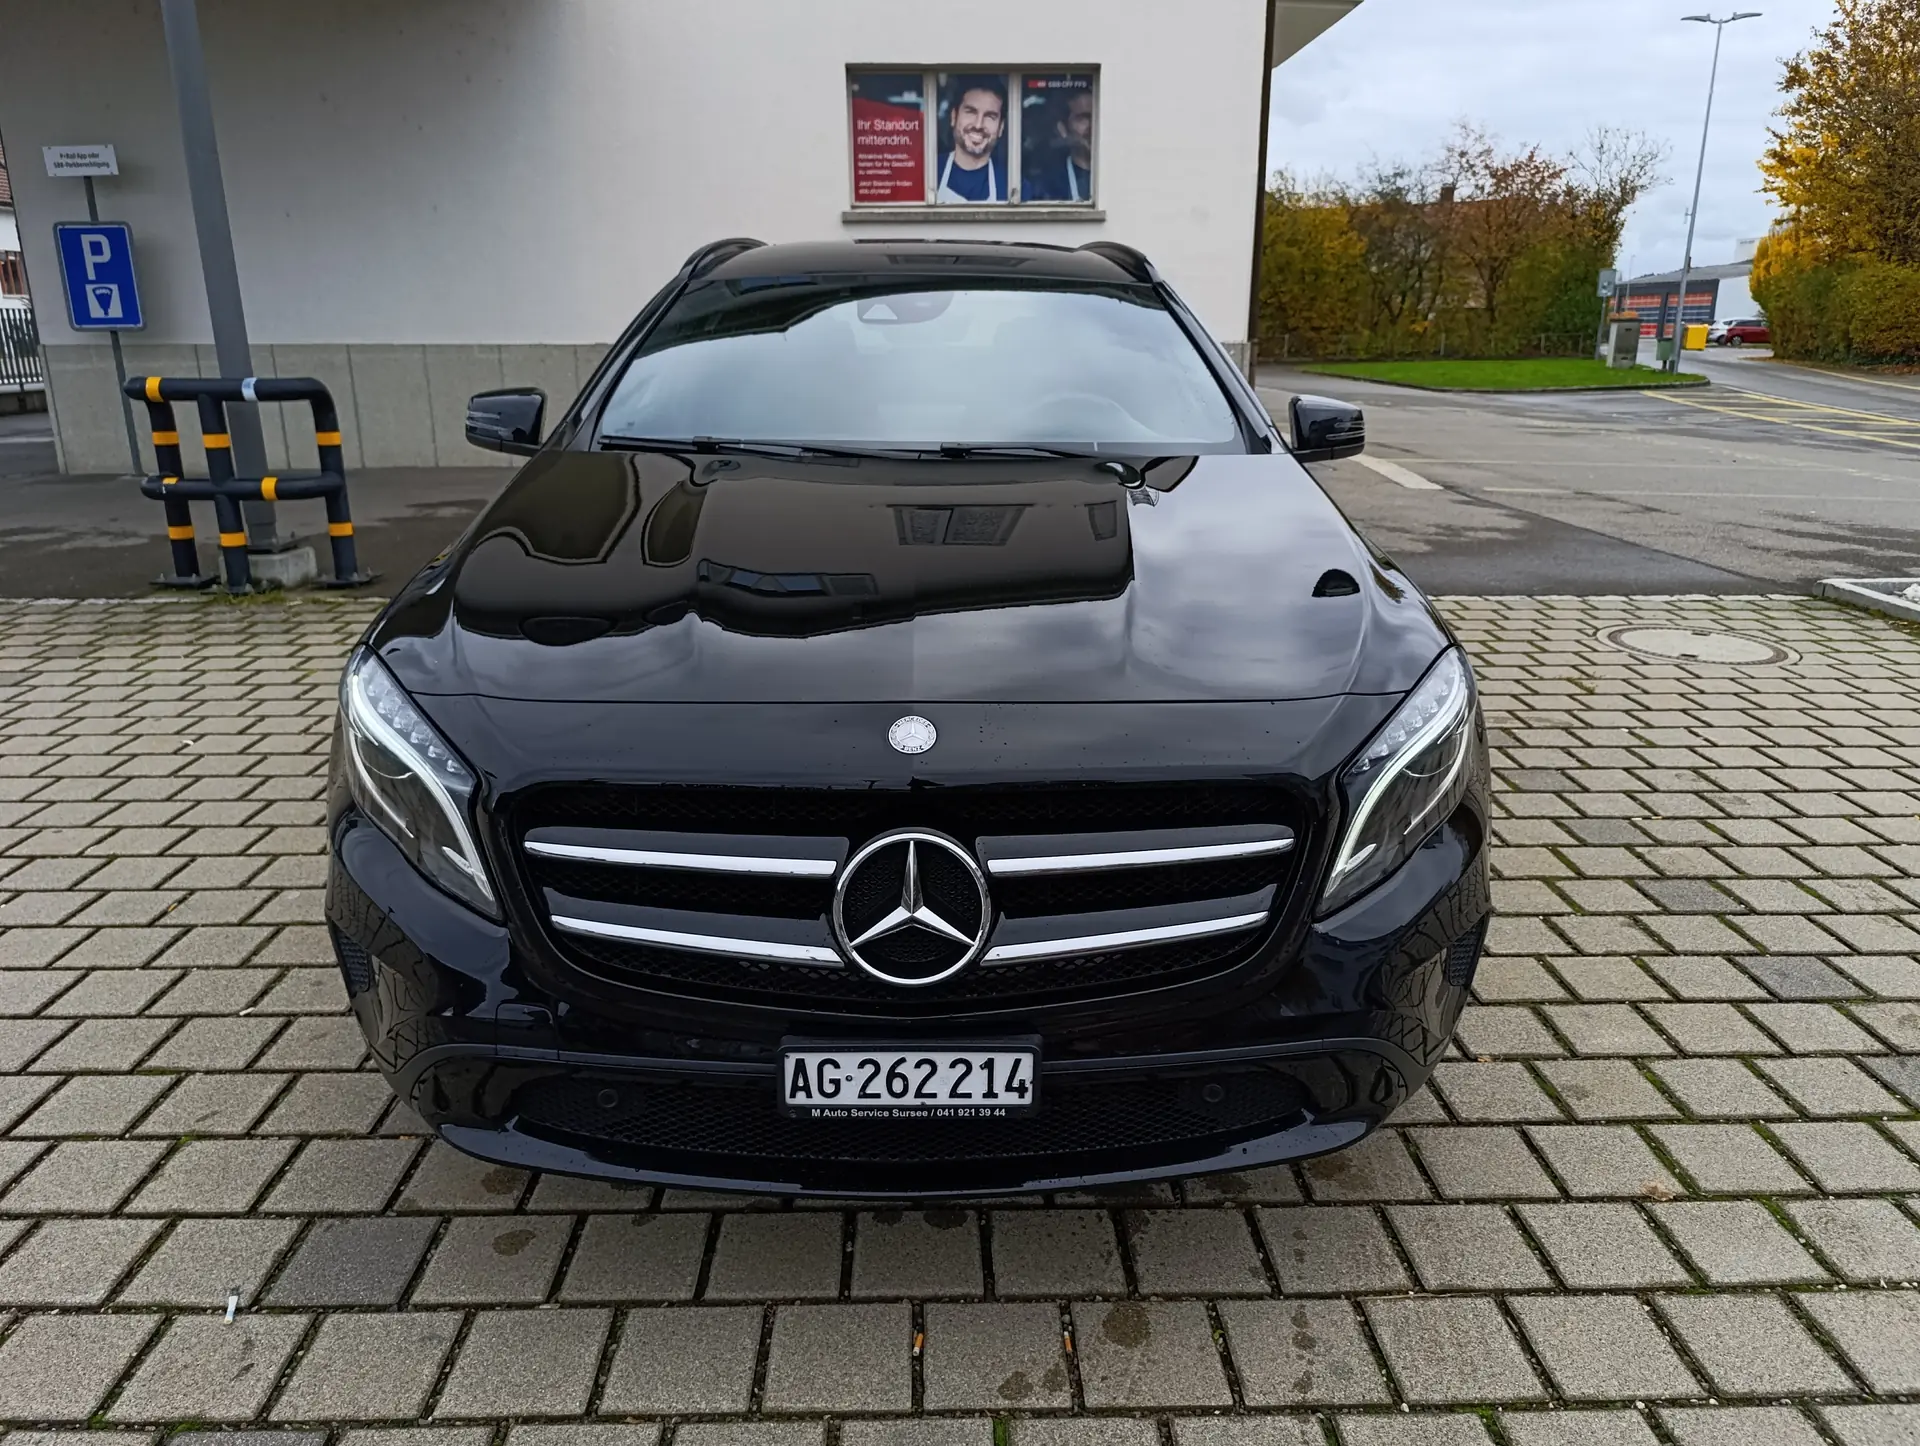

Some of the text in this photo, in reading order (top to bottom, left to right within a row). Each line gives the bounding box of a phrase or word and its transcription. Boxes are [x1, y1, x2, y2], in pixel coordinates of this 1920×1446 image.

[857, 119, 919, 131] Ihr Standort
[857, 135, 912, 145] mittendrin.
[80, 234, 112, 281] P
[811, 1108, 821, 1117] M
[823, 1108, 848, 1117] Auto
[850, 1108, 889, 1117] Service
[891, 1108, 928, 1117] Sursee
[937, 1107, 957, 1116] 041
[958, 1107, 977, 1116] 921
[979, 1107, 991, 1116] 39
[993, 1107, 1006, 1116] 44
